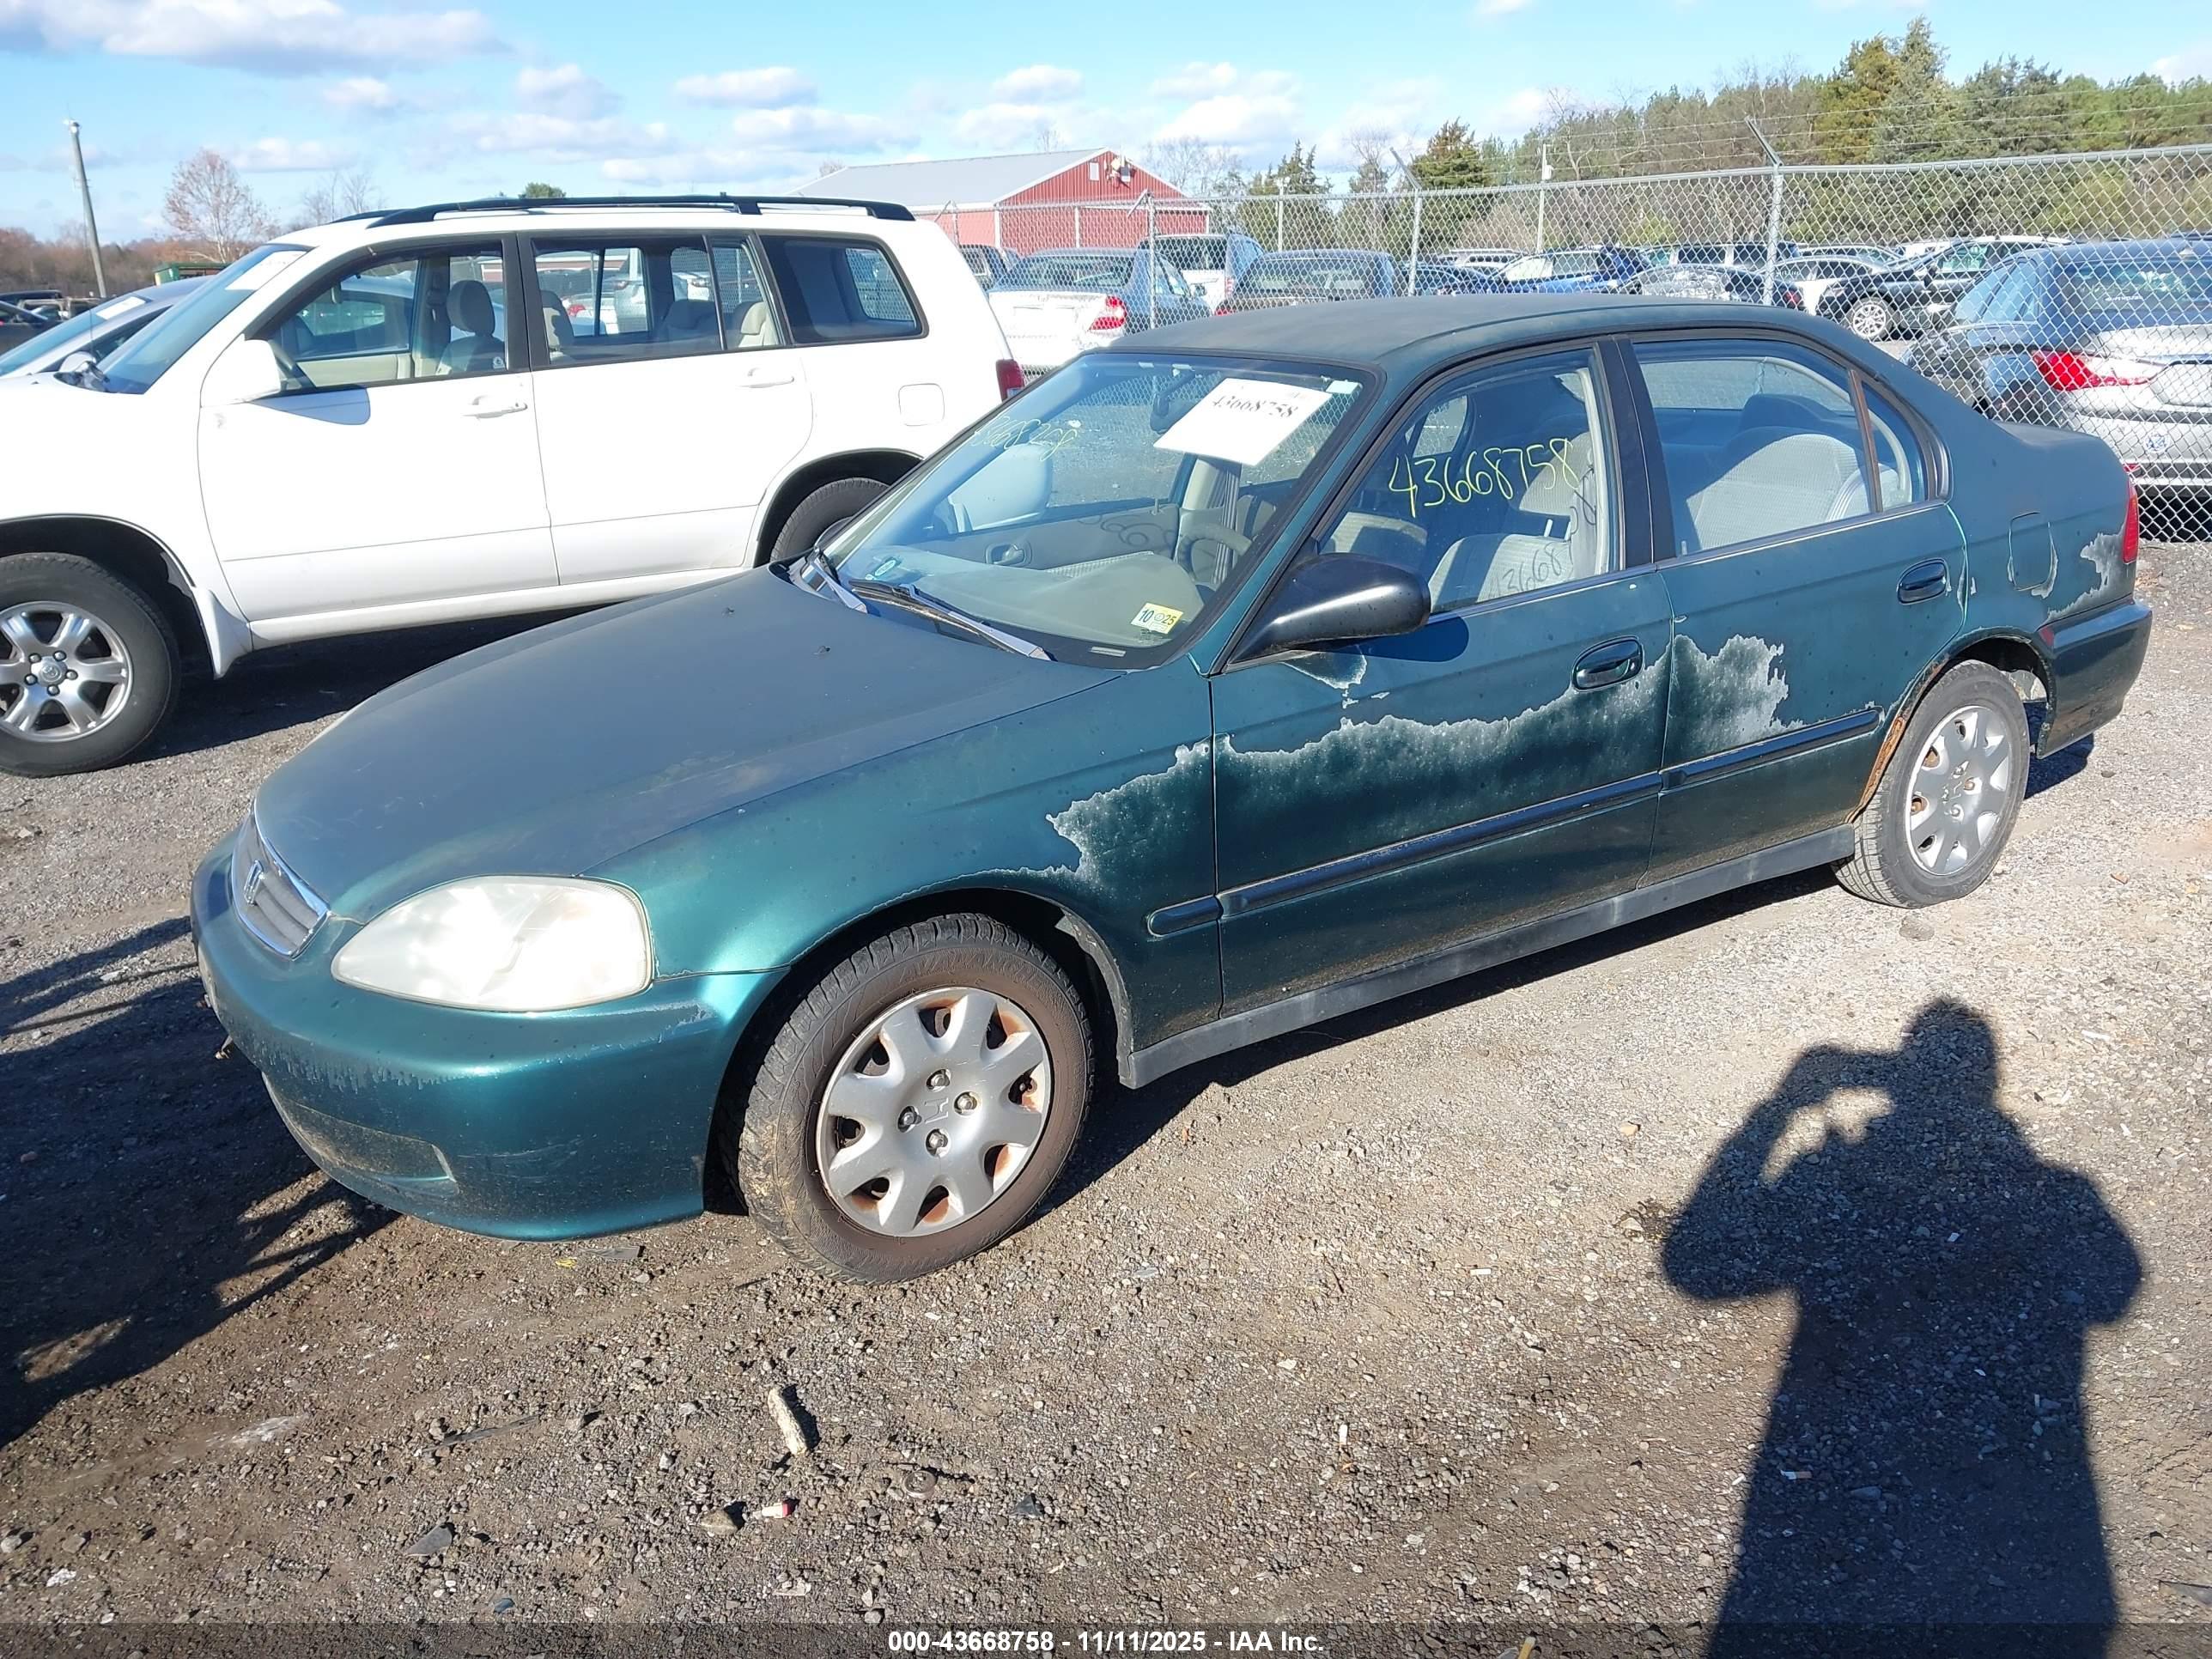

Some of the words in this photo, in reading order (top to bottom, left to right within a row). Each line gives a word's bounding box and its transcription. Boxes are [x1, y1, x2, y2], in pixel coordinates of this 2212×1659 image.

[1212, 395, 1298, 418] 43668758
[1389, 437, 1580, 519] 43668758
[1138, 608, 1155, 623] 10
[1161, 614, 1177, 626] 25
